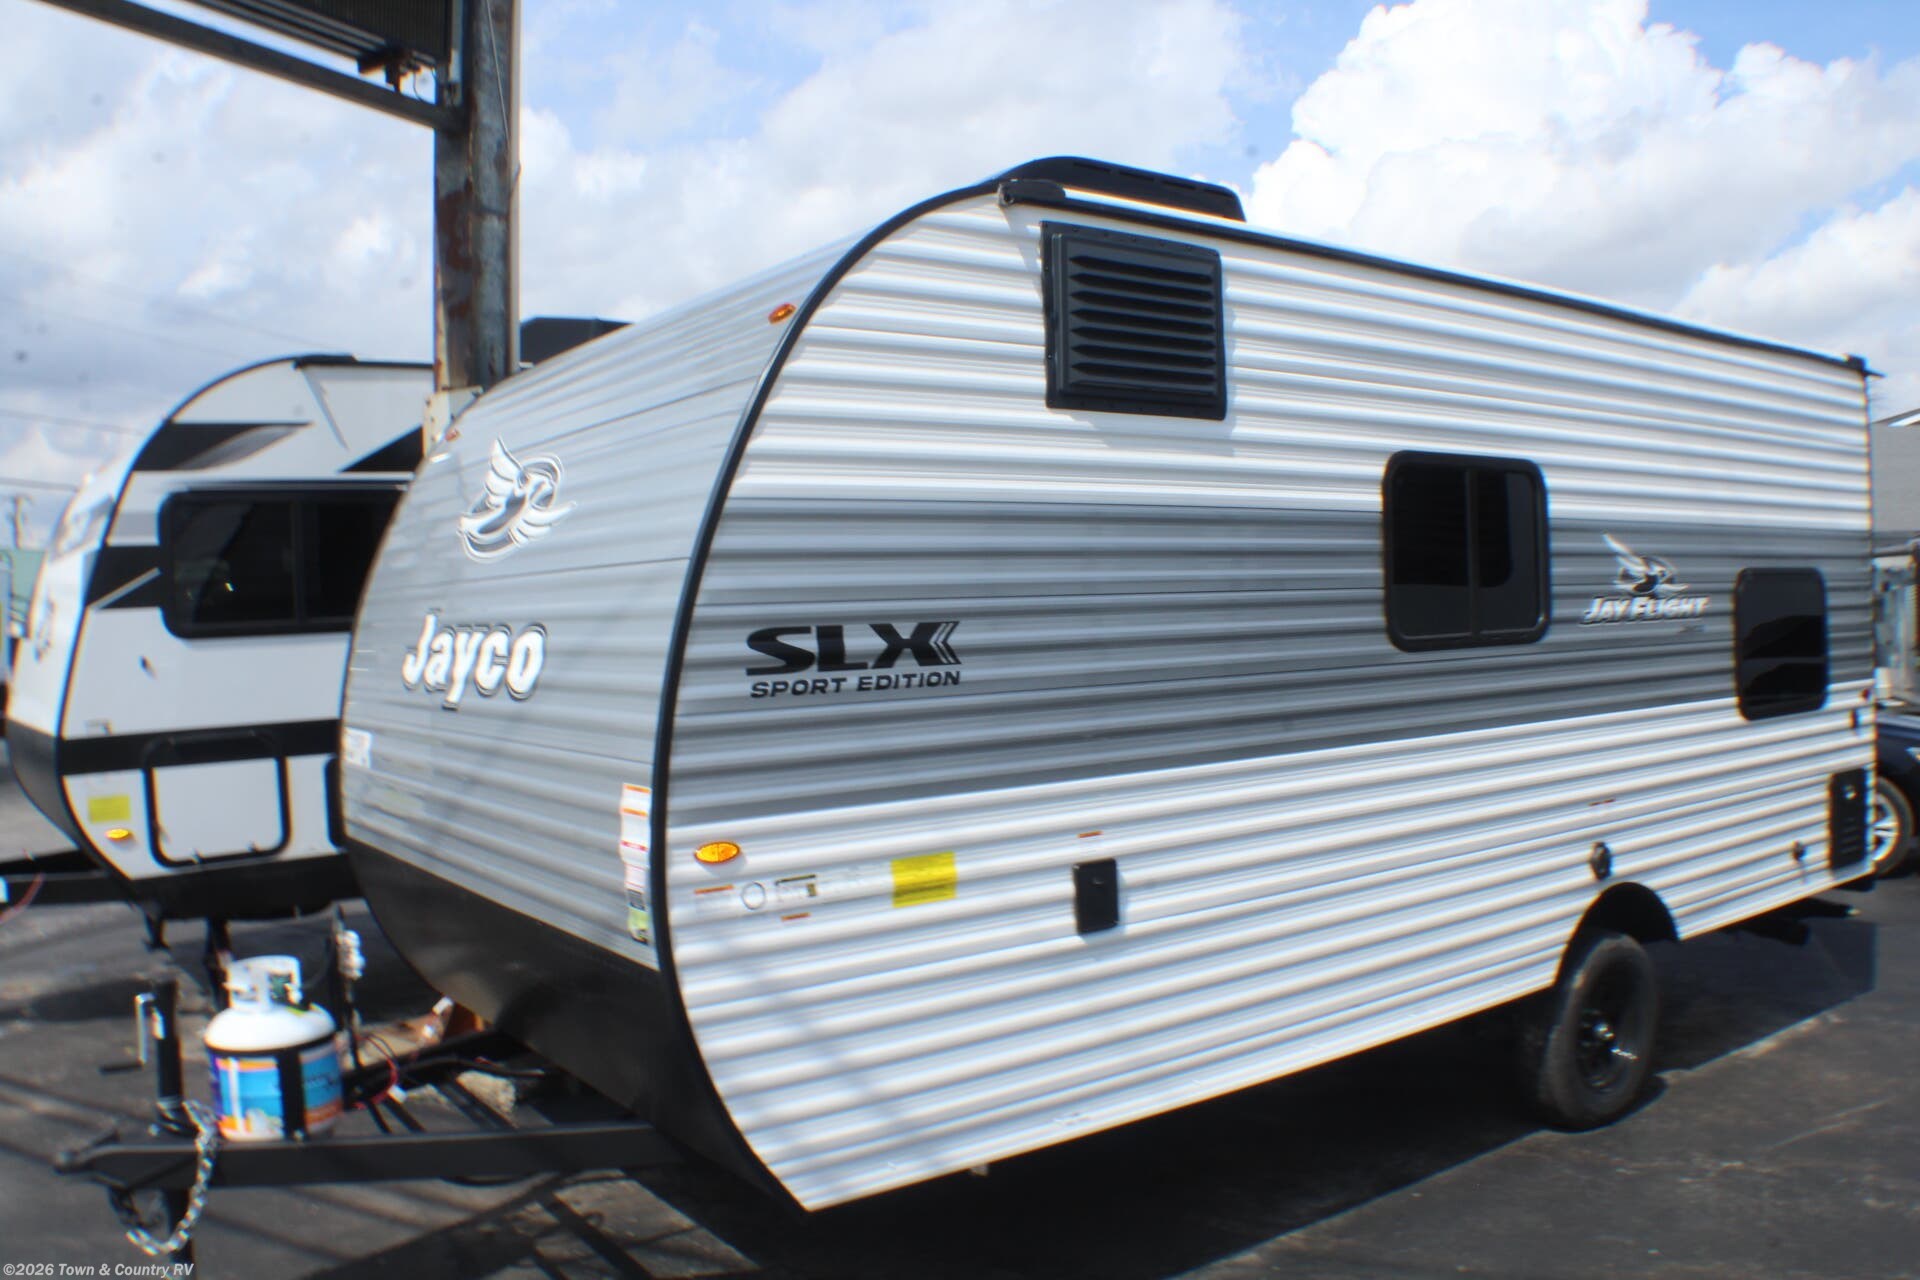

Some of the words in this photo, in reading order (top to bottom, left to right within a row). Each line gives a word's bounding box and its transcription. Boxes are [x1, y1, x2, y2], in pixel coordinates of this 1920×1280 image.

[1582, 596, 1631, 623] JAY
[1629, 595, 1711, 621] FLIGHT
[401, 612, 547, 709] Jayco
[746, 620, 962, 676] SLX
[750, 677, 848, 698] SPORT
[855, 670, 961, 692] EDITION
